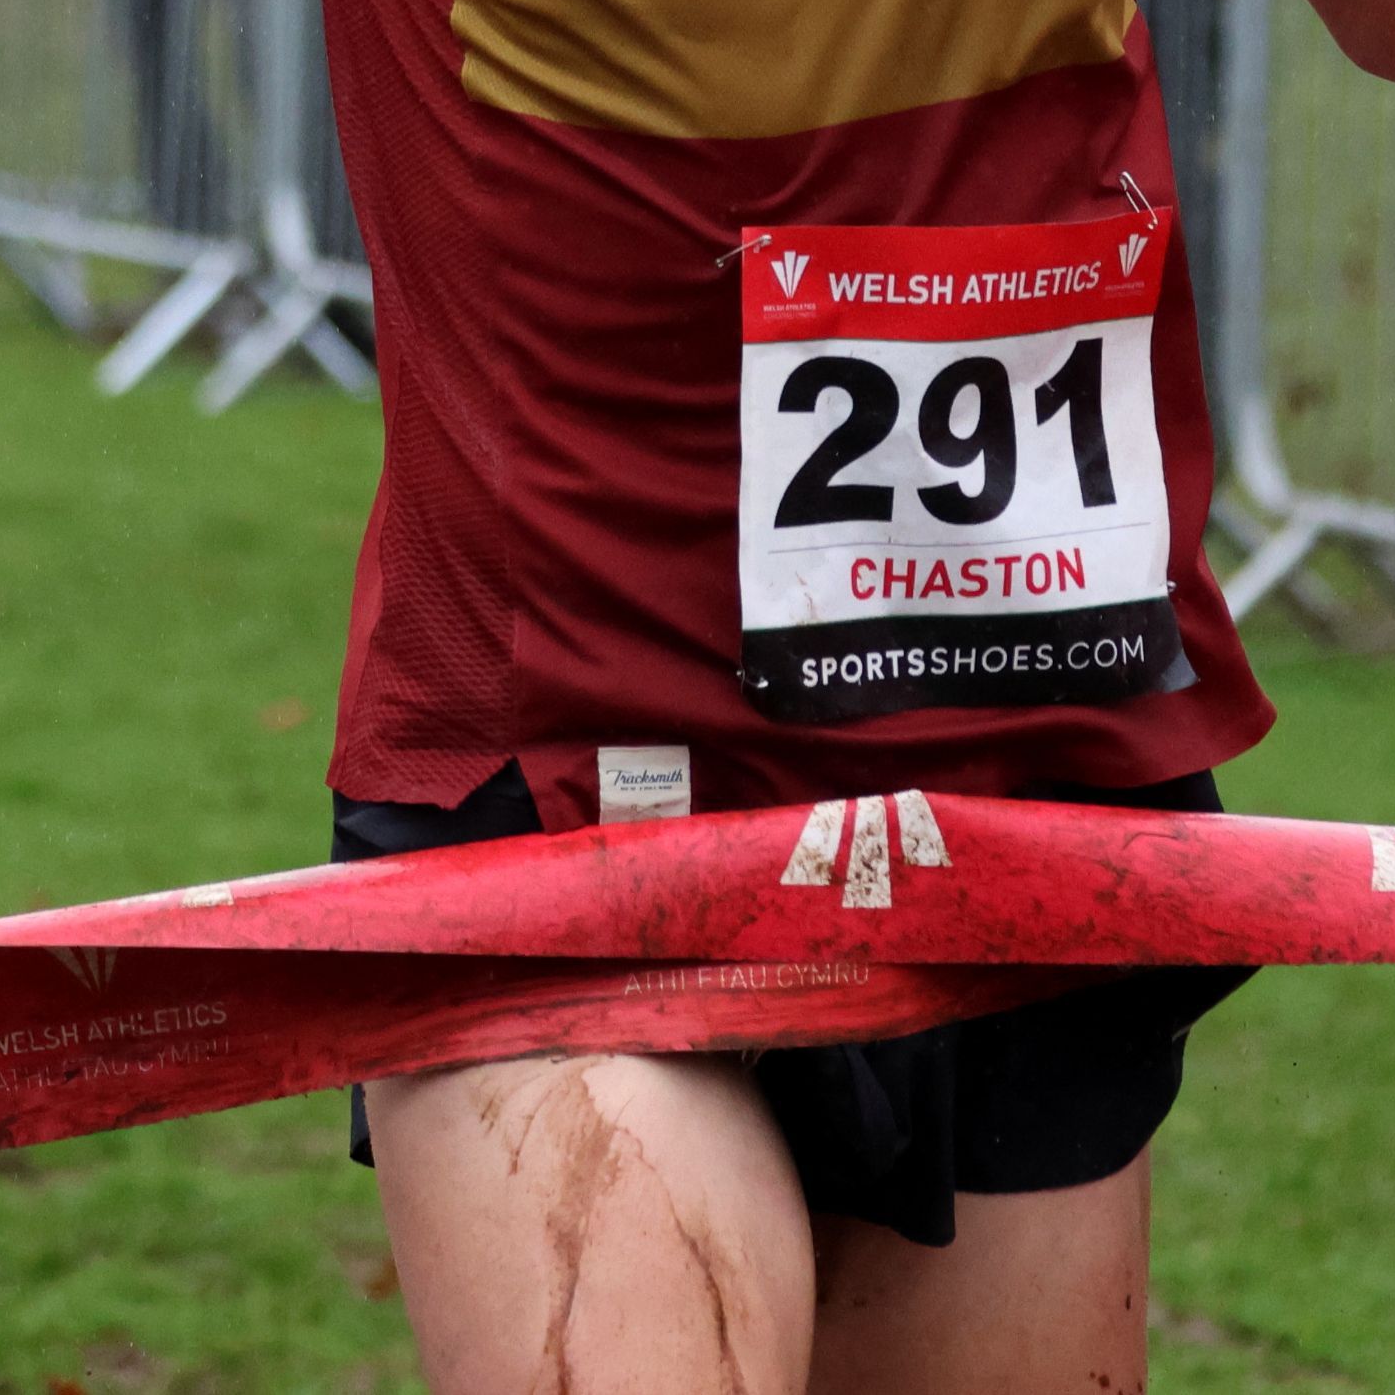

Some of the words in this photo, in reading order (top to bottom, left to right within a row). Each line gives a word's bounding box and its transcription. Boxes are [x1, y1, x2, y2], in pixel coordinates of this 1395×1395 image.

[828, 273, 953, 305] WELSH
[962, 262, 1101, 302] ATHLETICS
[774, 337, 1118, 529] 291
[850, 547, 1086, 600] CHASTON
[802, 635, 1145, 687] SPORTSSHOES.COM
[606, 768, 683, 786] Tracksmith
[777, 963, 869, 988] CYMRU
[88, 1001, 227, 1042] ATHLETICS
